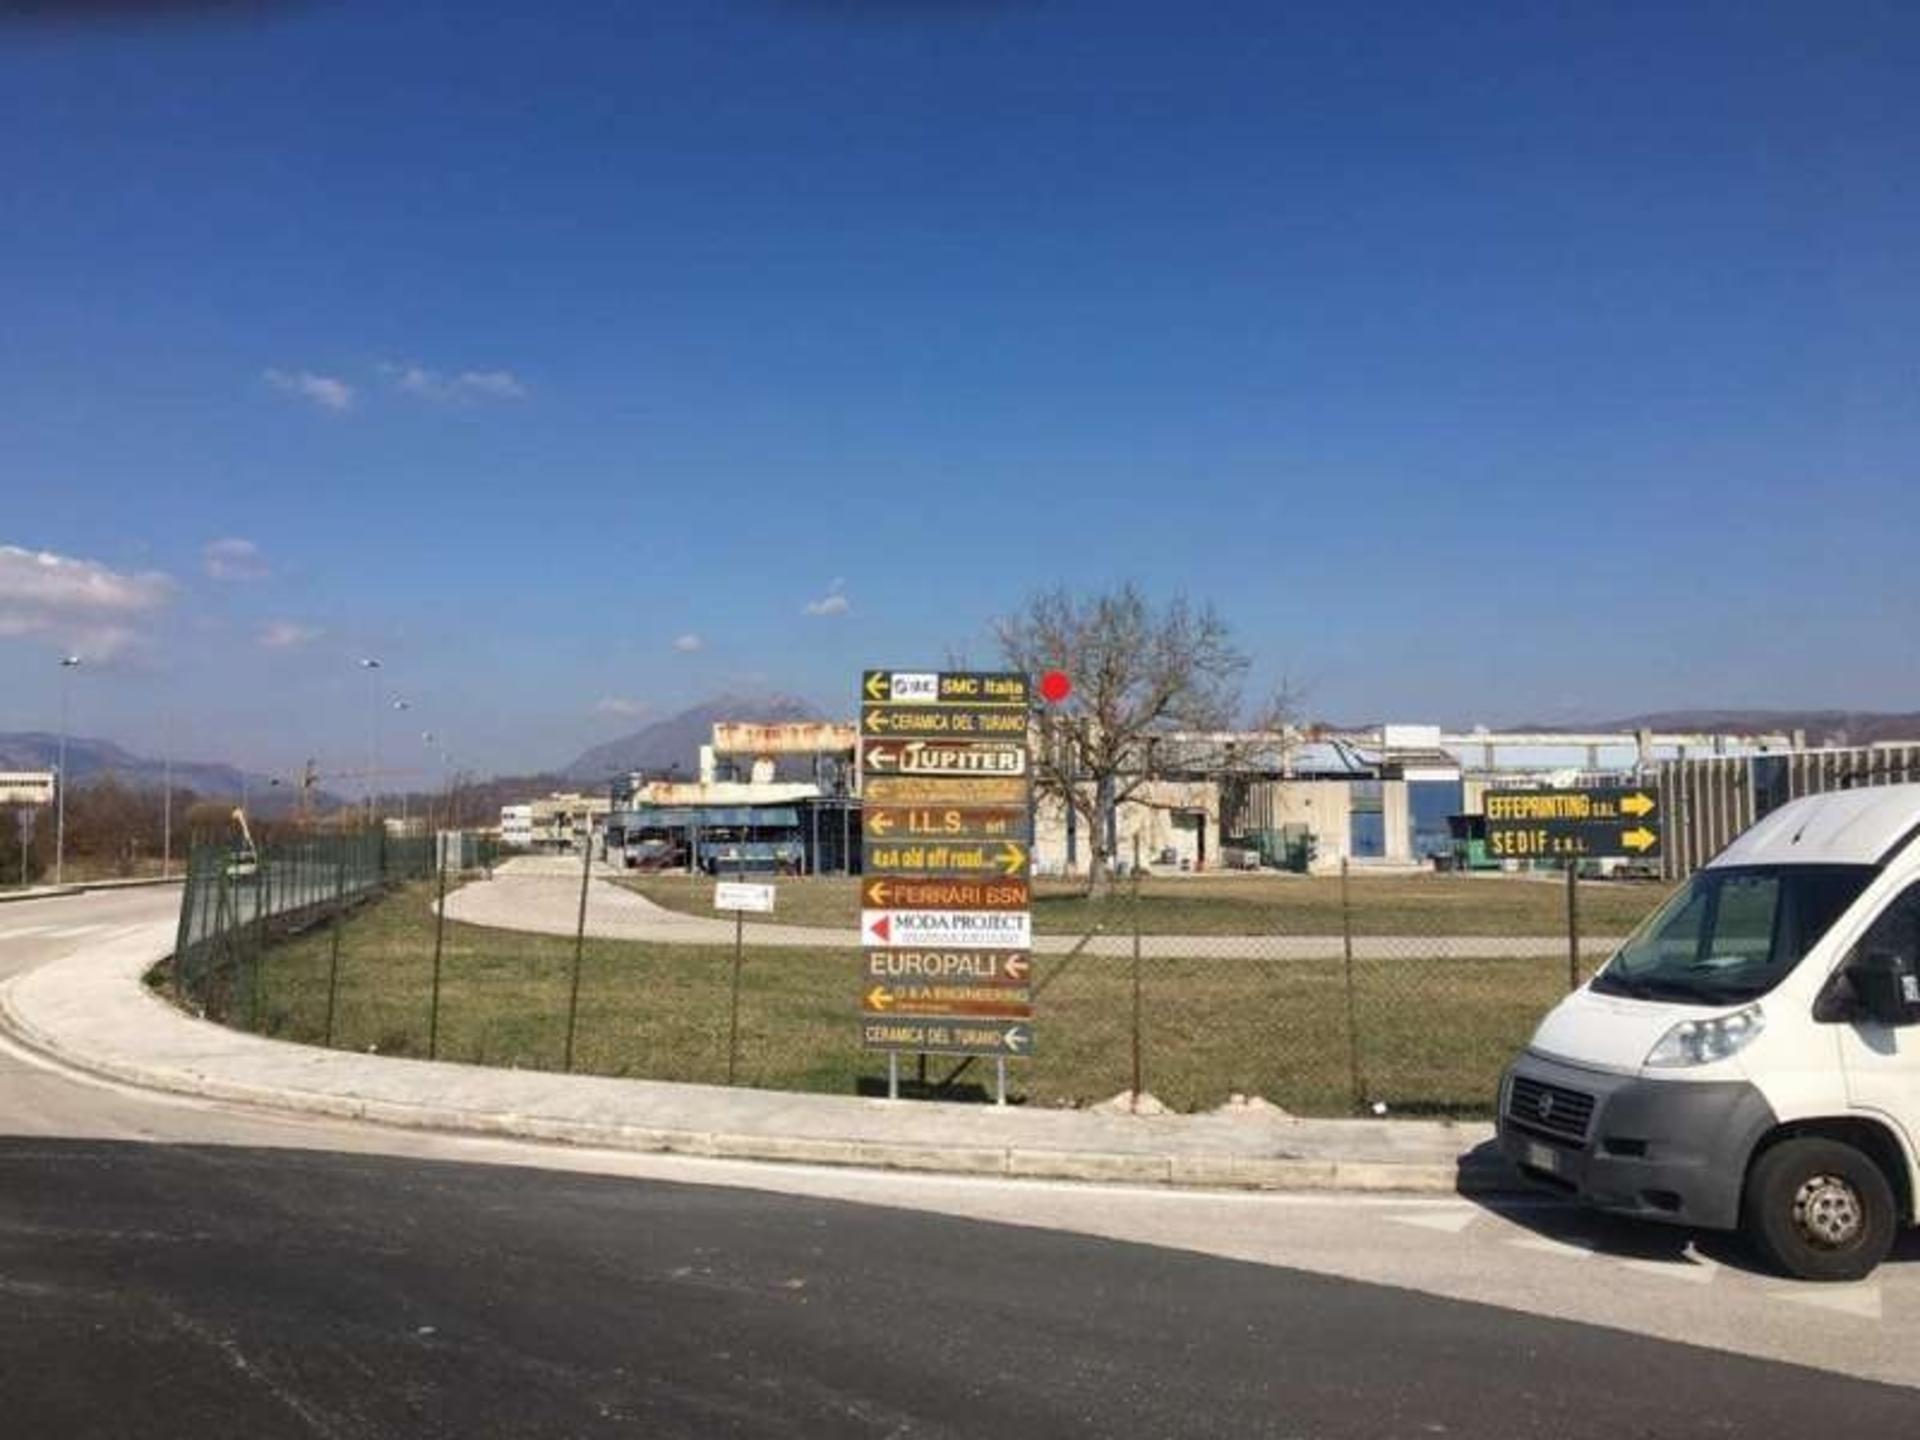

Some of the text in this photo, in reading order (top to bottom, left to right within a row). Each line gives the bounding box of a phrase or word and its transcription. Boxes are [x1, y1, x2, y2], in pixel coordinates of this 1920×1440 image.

[941, 679, 978, 694] SMC
[890, 716, 949, 731] CERAMICA
[952, 716, 977, 731] DEL
[902, 743, 1016, 769] JUPITER
[1491, 829, 1548, 853] SEDIF
[902, 846, 924, 867] old
[927, 846, 949, 867] off
[895, 915, 1024, 930] MODA PROJECT
[870, 953, 997, 976] EUROPALI
